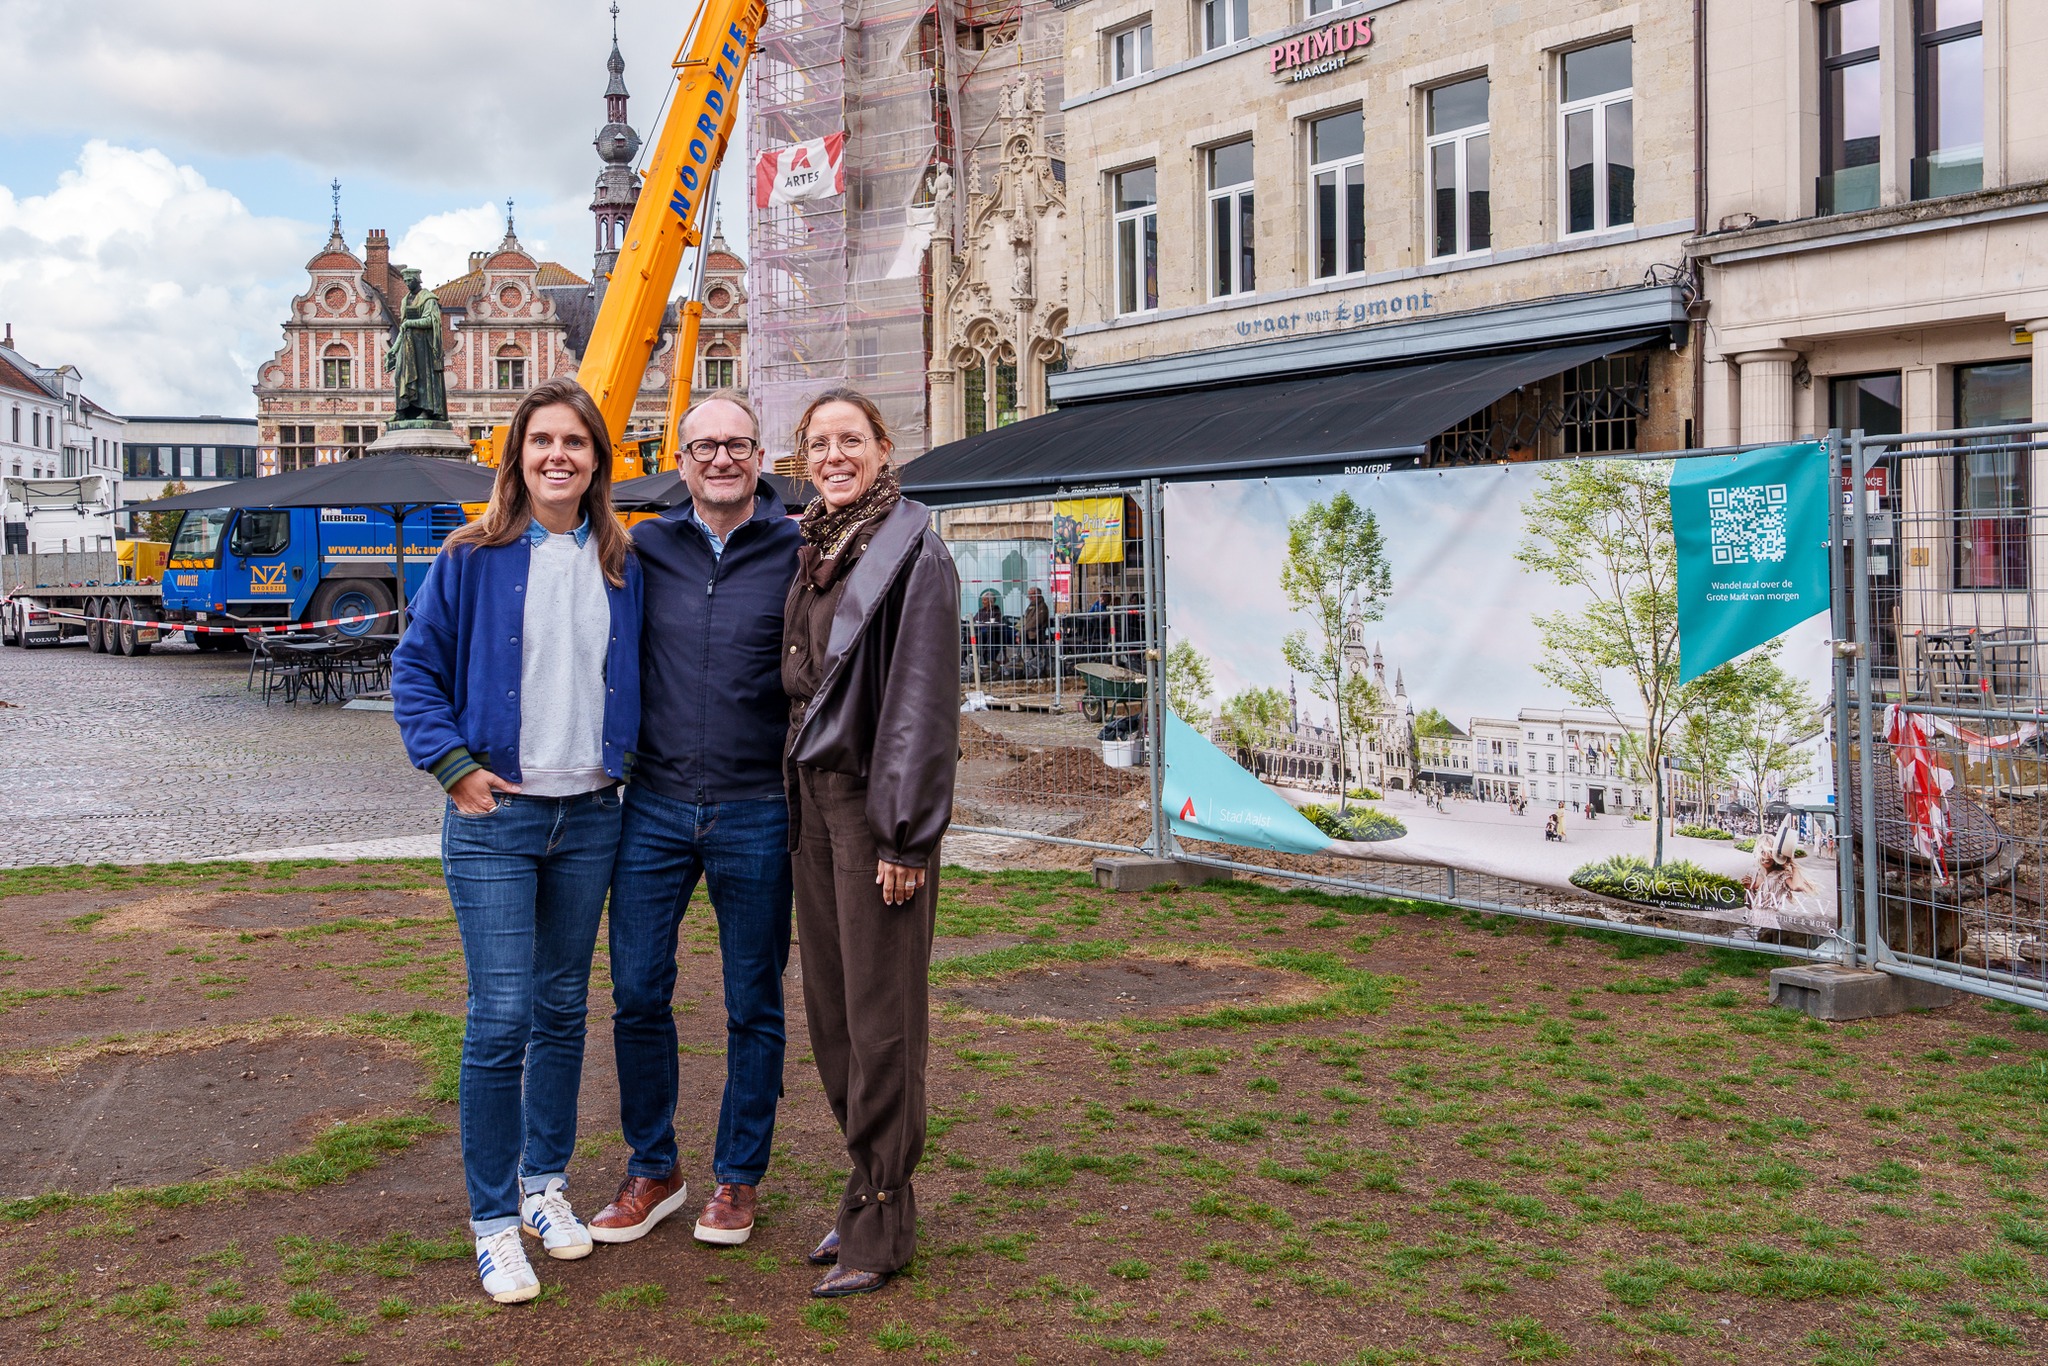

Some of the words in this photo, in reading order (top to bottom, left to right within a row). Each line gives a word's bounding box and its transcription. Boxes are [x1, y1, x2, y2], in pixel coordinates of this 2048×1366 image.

[1269, 17, 1372, 74] PRIMUS
[1293, 57, 1346, 81] HAACHT
[669, 22, 748, 221] NOORDZEE
[784, 170, 820, 188] ARTES
[1306, 309, 1330, 324] van
[1334, 289, 1433, 323] Egmont
[321, 514, 366, 522] LIEBHERR
[1081, 513, 1106, 530] Prins
[176, 574, 199, 587] NOORDZEE
[1711, 581, 1742, 590] Wandel
[1752, 580, 1760, 589] al
[1760, 581, 1780, 589] over
[1781, 579, 1793, 589] de
[1706, 593, 1729, 602] Grote
[1729, 592, 1749, 601] Markt
[1750, 593, 1765, 601] van
[1766, 592, 1800, 603] morgen
[1220, 808, 1243, 824] Stad
[1244, 811, 1272, 827] Aalst
[1623, 876, 1736, 904] OMGEVING
[1660, 900, 1701, 910] ARCHITECTURE
[1809, 919, 1831, 929] MORE
